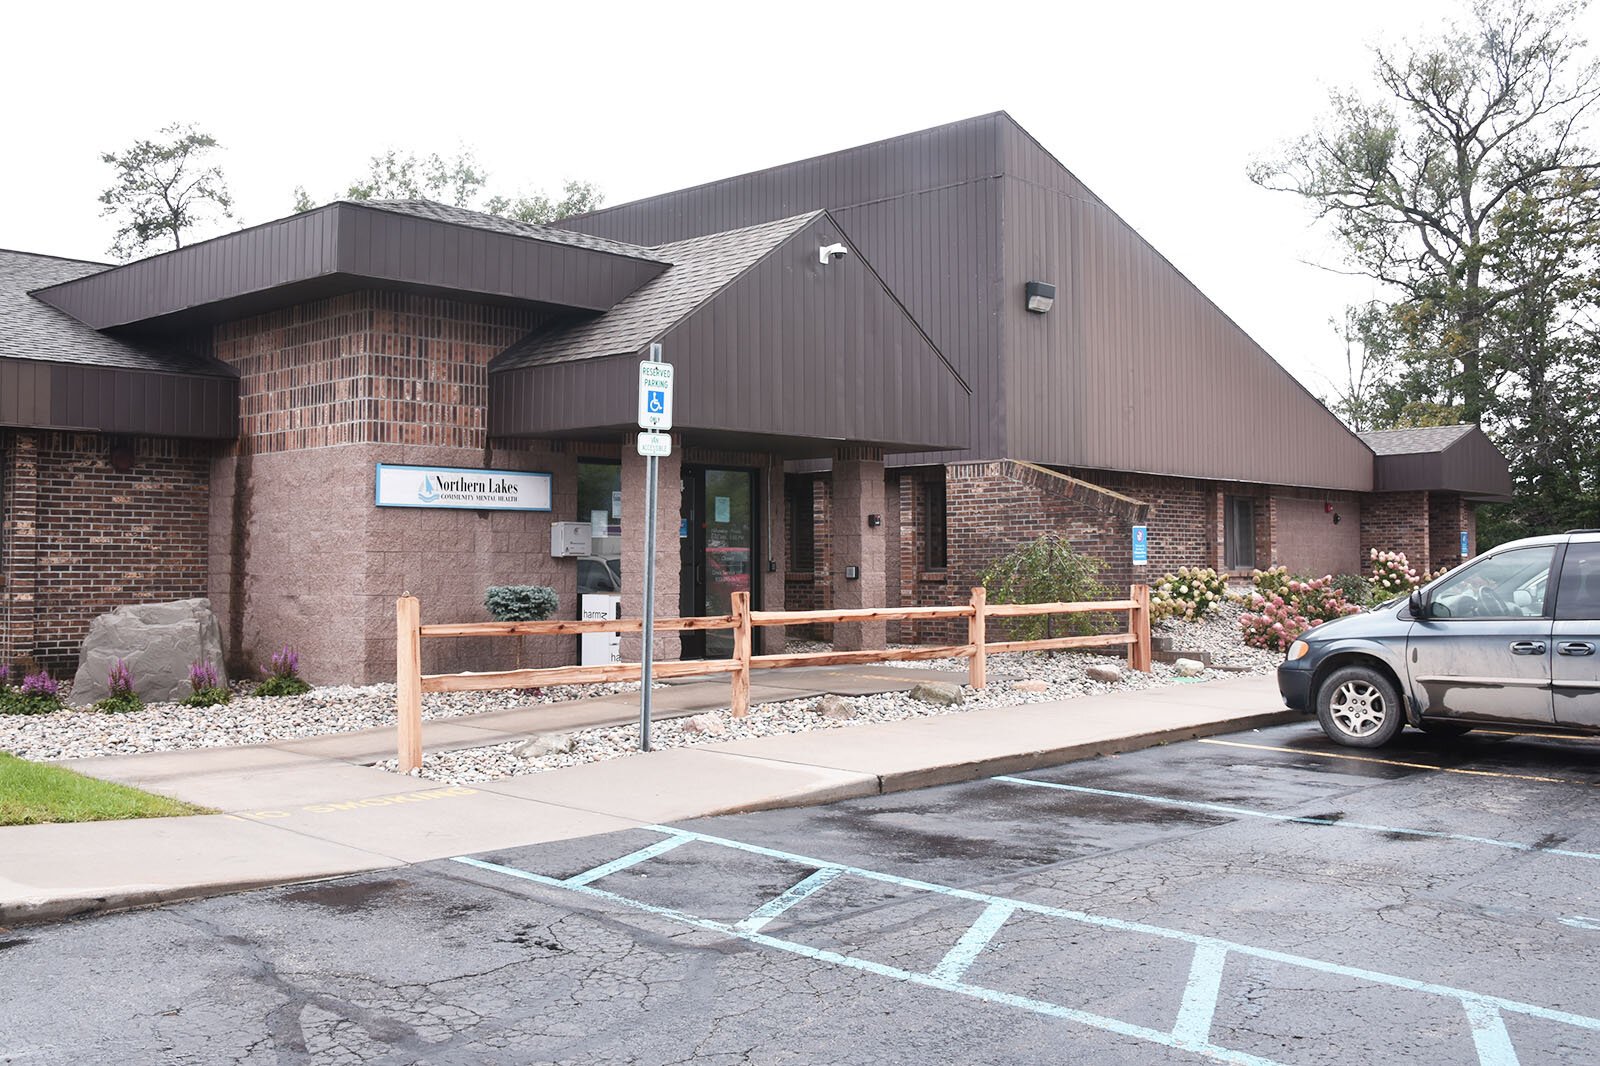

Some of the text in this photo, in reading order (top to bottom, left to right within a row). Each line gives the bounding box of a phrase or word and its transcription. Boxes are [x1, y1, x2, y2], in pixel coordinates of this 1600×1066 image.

[642, 366, 670, 378] RESERVED
[644, 379, 668, 388] PARKING
[436, 476, 518, 494] Northern Lakes
[610, 652, 621, 662] ha
